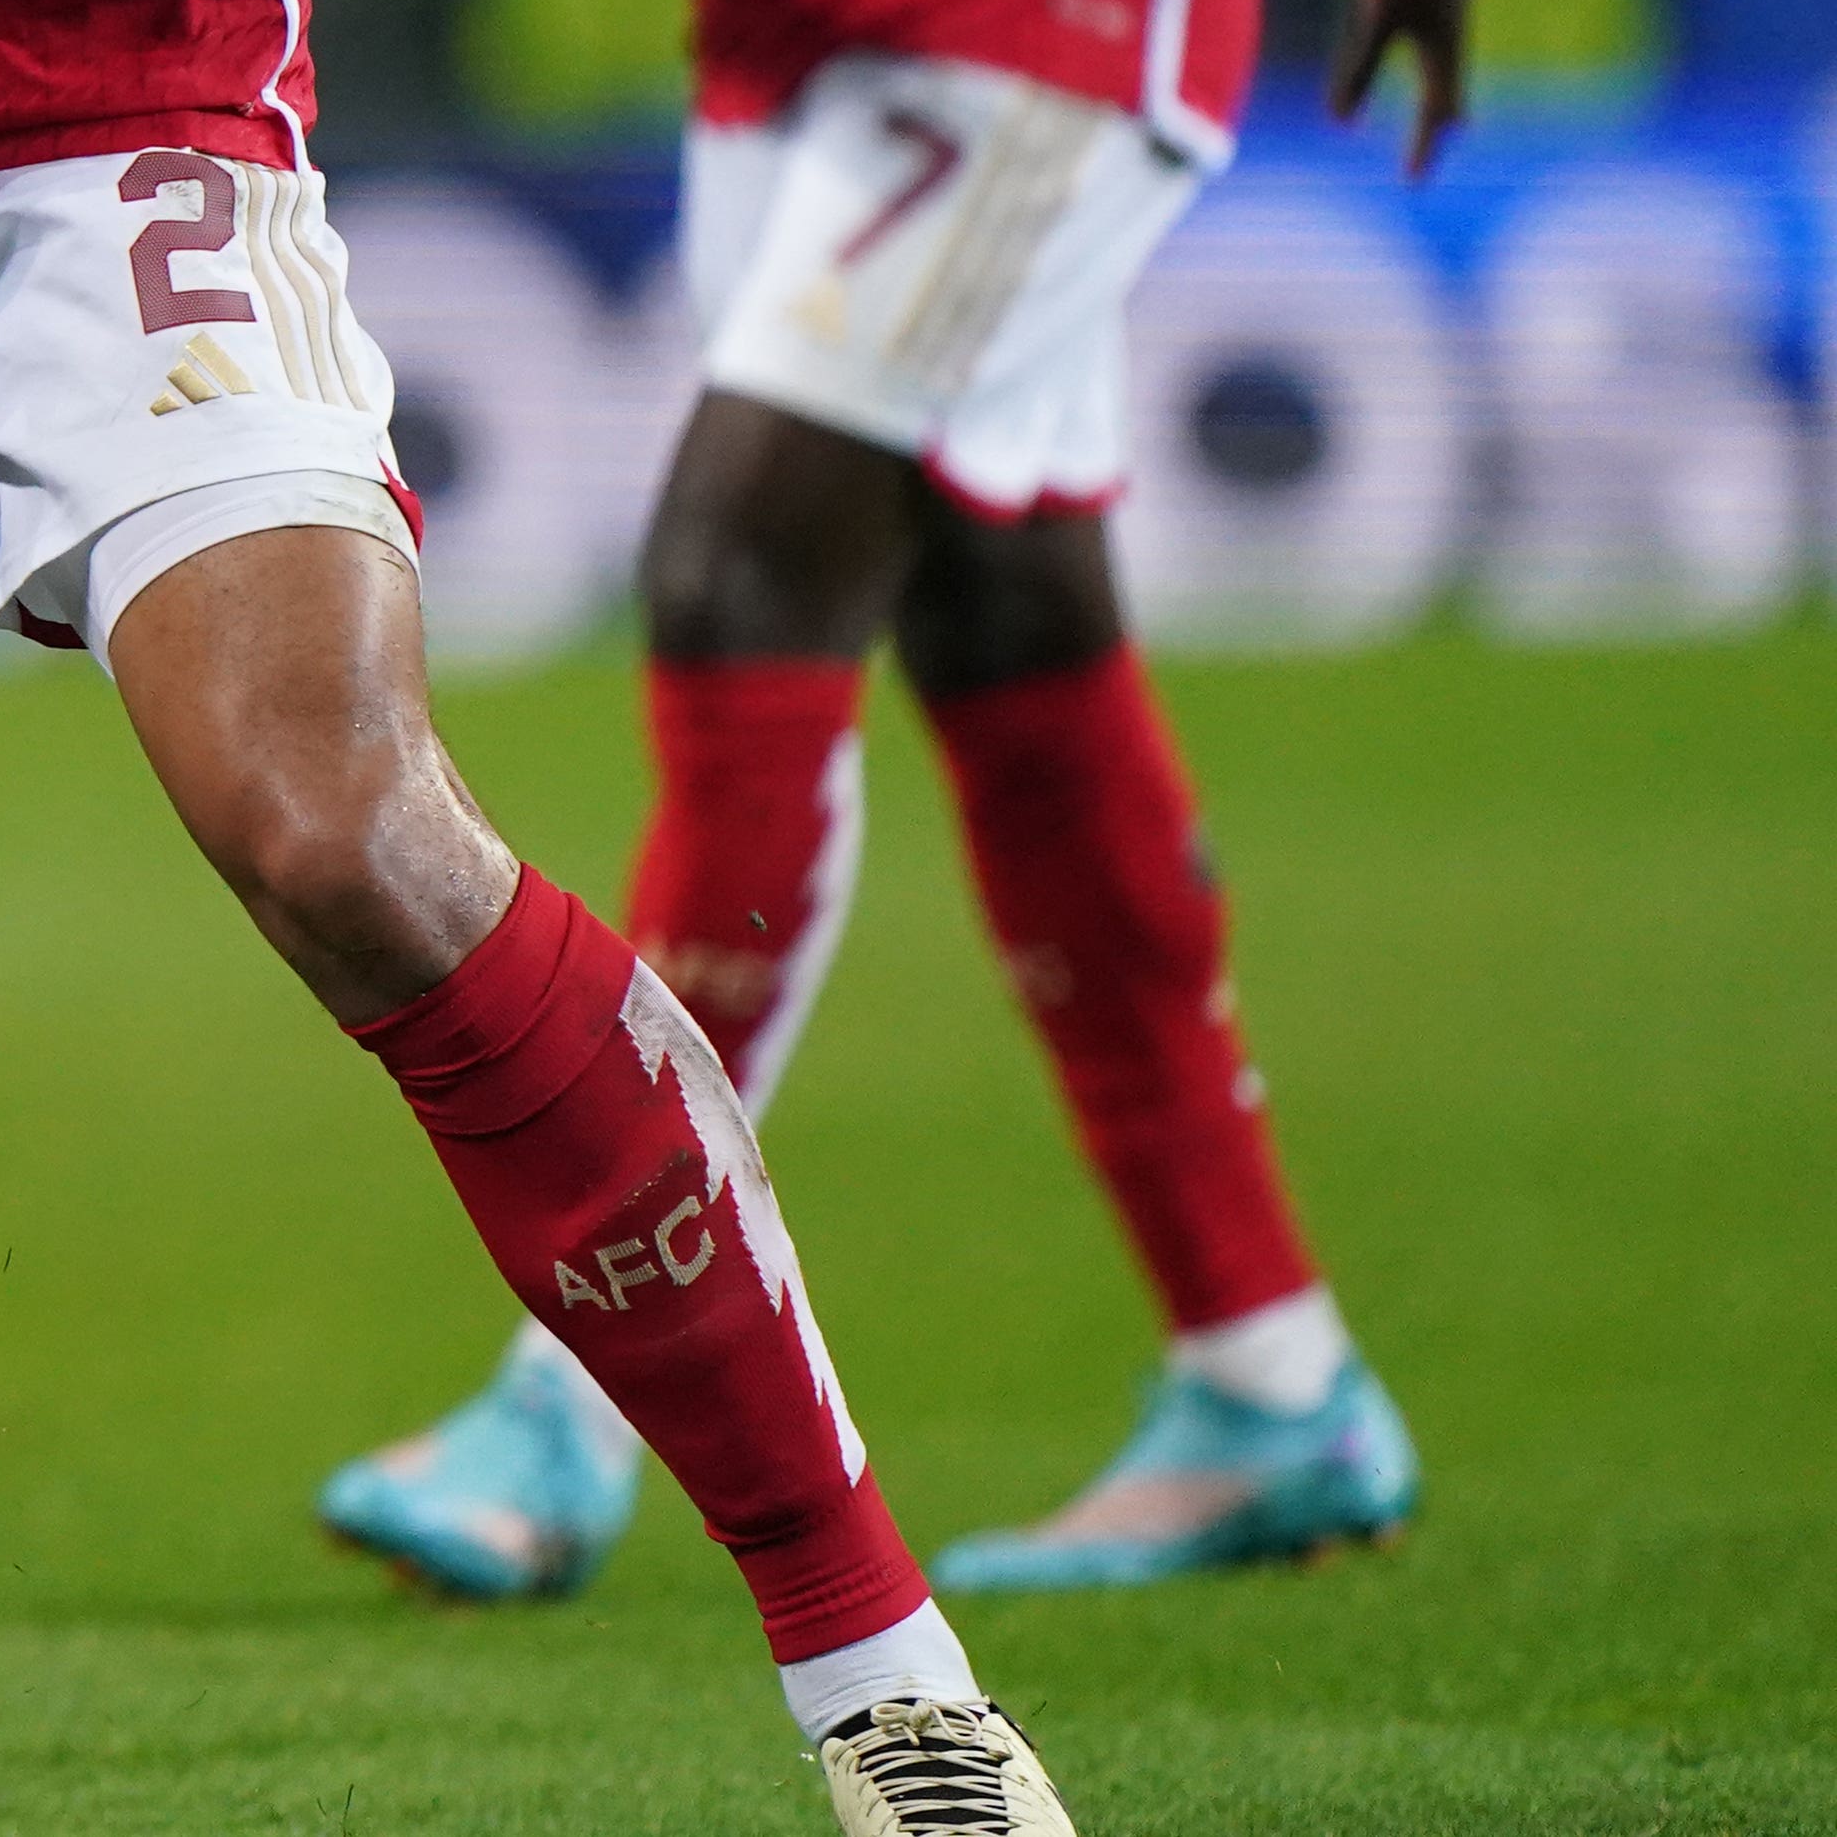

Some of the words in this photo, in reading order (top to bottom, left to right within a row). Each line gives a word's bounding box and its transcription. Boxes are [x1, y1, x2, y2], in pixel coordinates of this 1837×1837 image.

[117, 151, 257, 336] 2
[831, 103, 963, 271] 7
[553, 1195, 717, 1311] AFC
